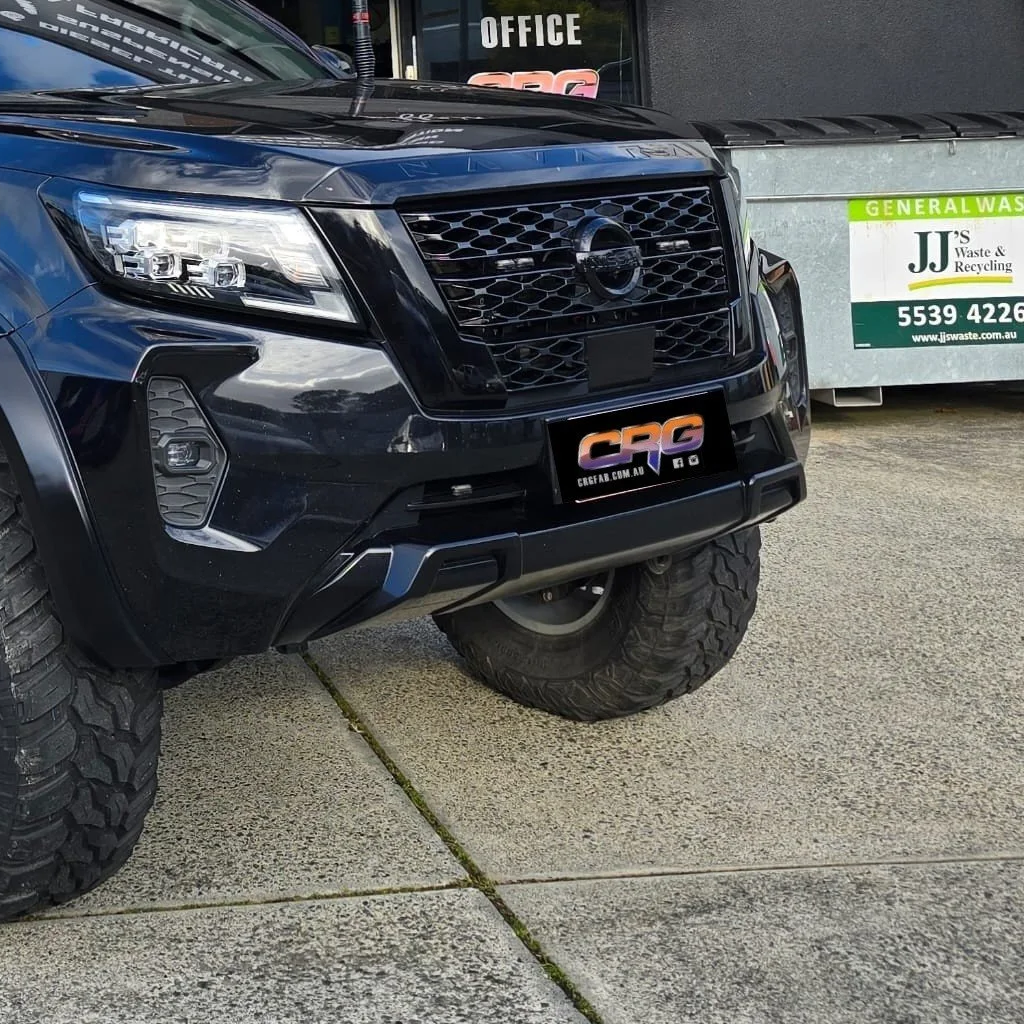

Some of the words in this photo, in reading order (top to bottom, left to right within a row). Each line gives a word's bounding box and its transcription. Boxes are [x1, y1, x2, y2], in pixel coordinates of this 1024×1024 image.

[480, 13, 582, 49] OFFICE
[865, 196, 971, 217] GENERAL
[908, 229, 971, 274] JJ'S
[954, 246, 991, 258] Waste
[995, 245, 1006, 257] &
[954, 259, 1013, 275] Recycling
[897, 304, 957, 327] 5539
[966, 302, 1024, 324] 4226
[911, 331, 1017, 343] www.jjswaste.com.au
[578, 413, 705, 476] CRG
[577, 466, 645, 488] CRGFAB.COM.AU
